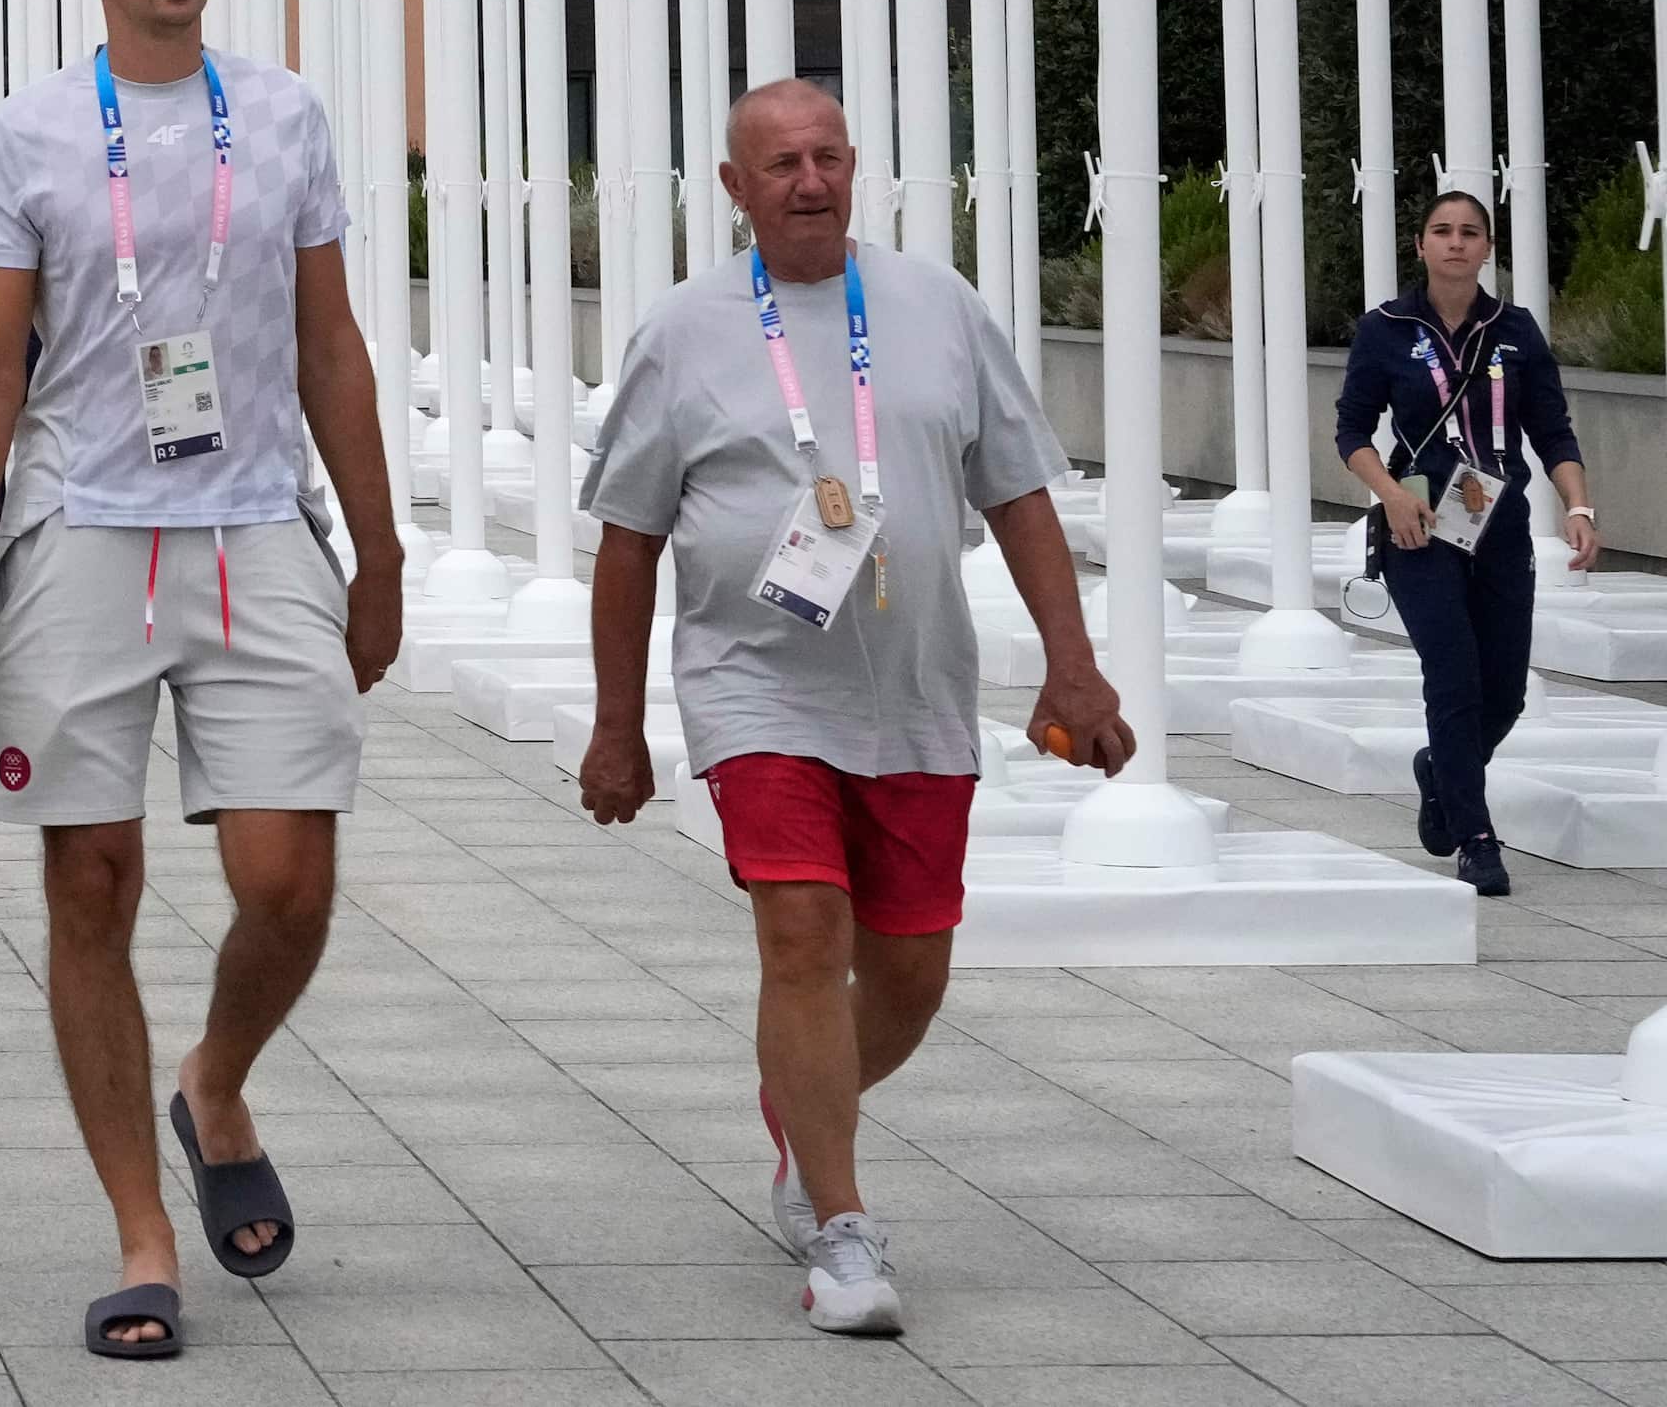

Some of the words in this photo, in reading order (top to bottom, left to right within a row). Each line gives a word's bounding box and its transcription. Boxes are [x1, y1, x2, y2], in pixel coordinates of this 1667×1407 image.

[146, 124, 190, 145] 4F
[211, 436, 221, 447] R
[815, 611, 827, 624] R
